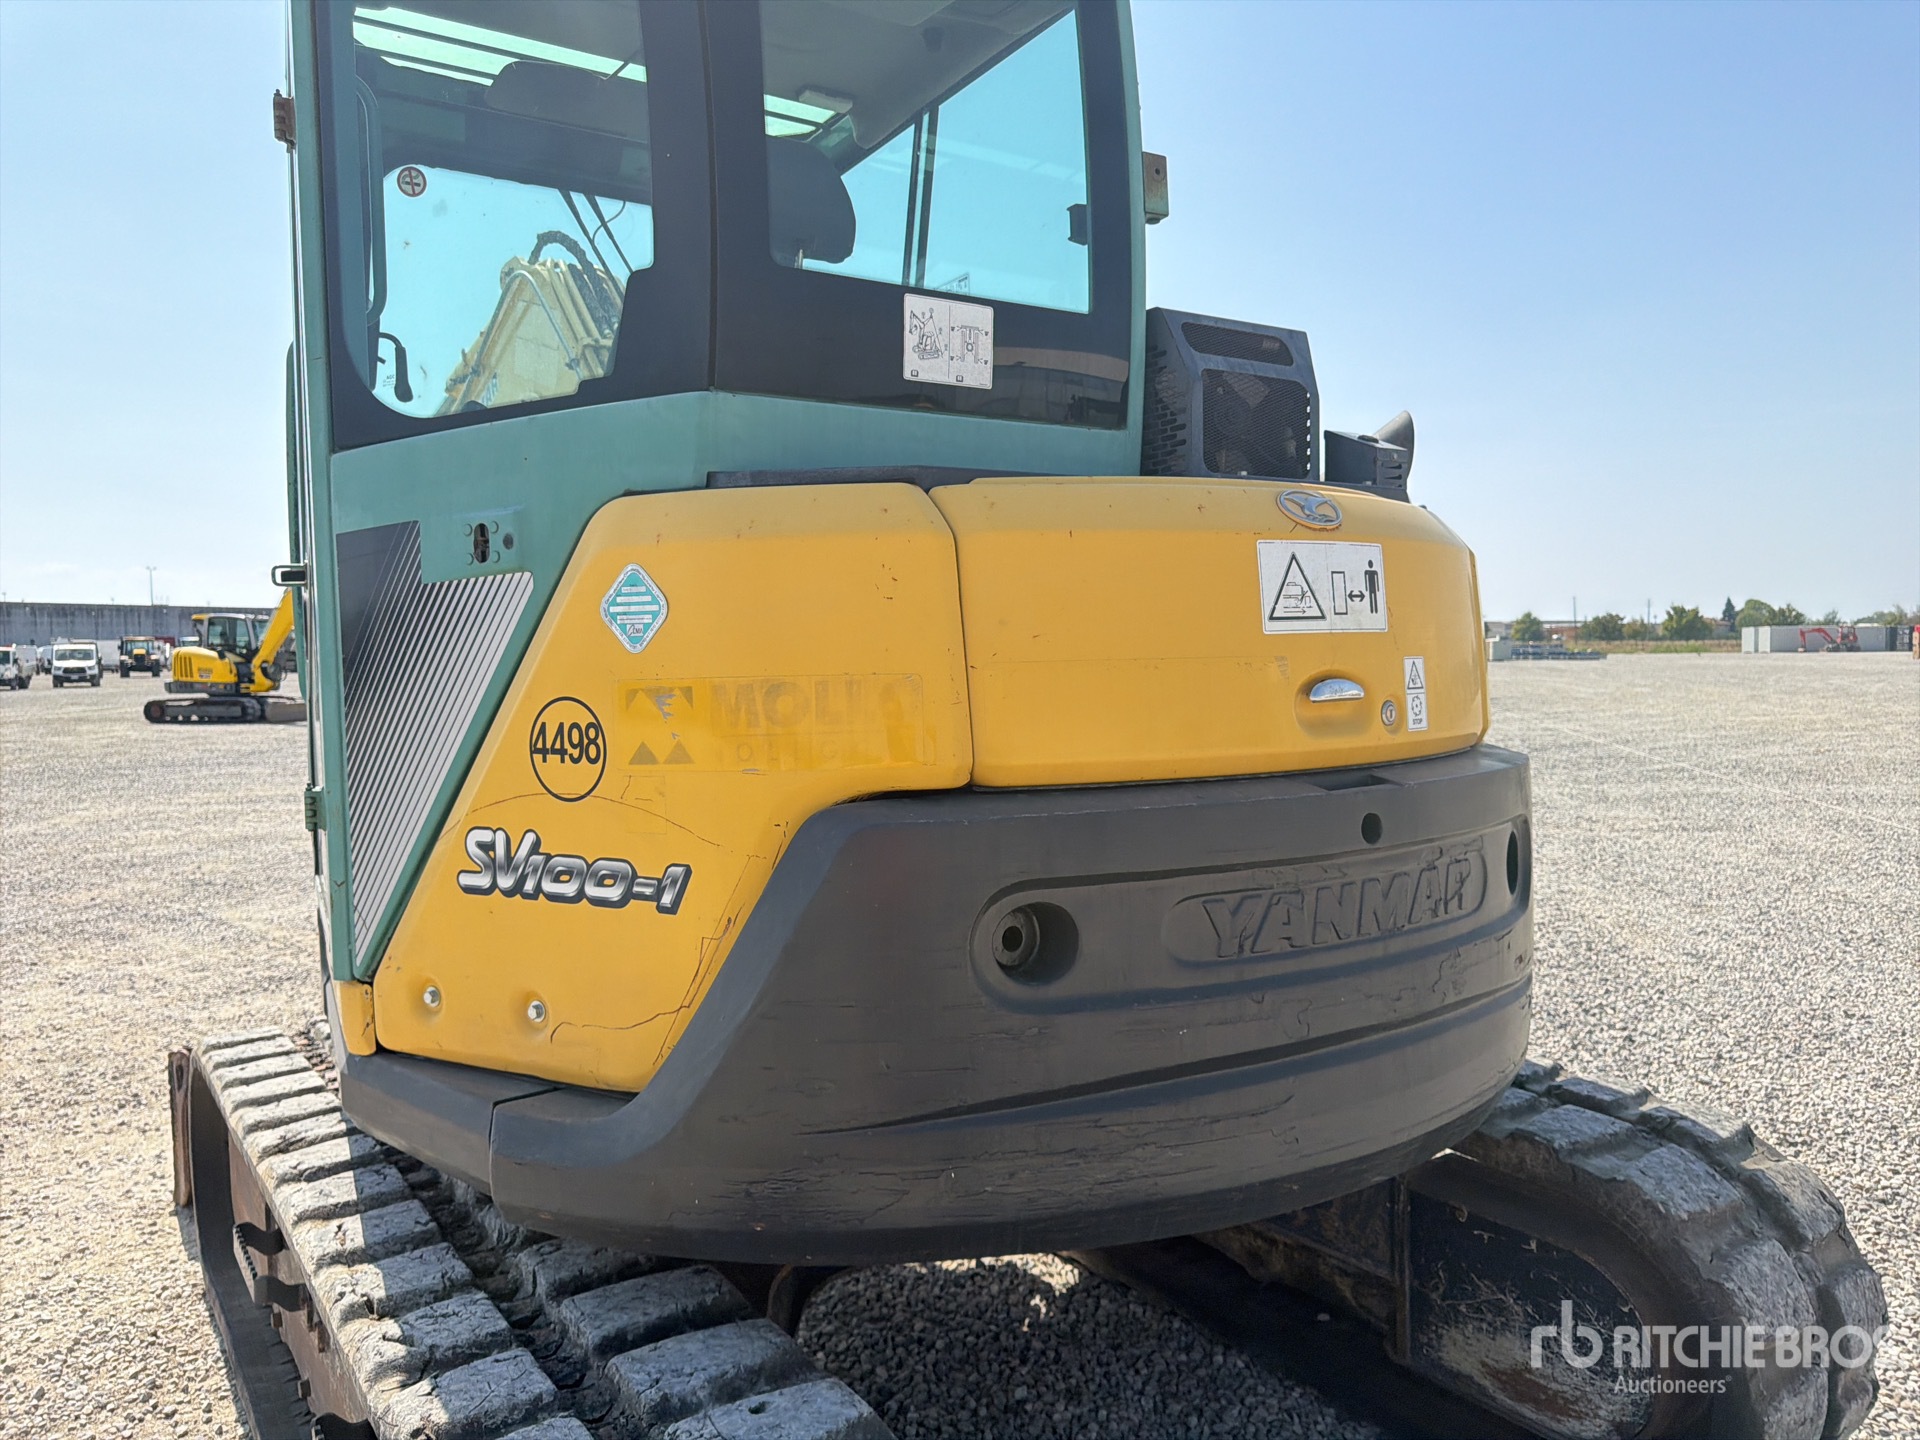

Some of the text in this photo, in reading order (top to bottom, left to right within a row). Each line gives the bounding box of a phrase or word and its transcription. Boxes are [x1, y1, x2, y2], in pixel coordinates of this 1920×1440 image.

[532, 722, 601, 764] 4498
[1412, 718, 1423, 726] STOP
[457, 827, 692, 914] SV100-1
[1202, 858, 1470, 957] YANMAR
